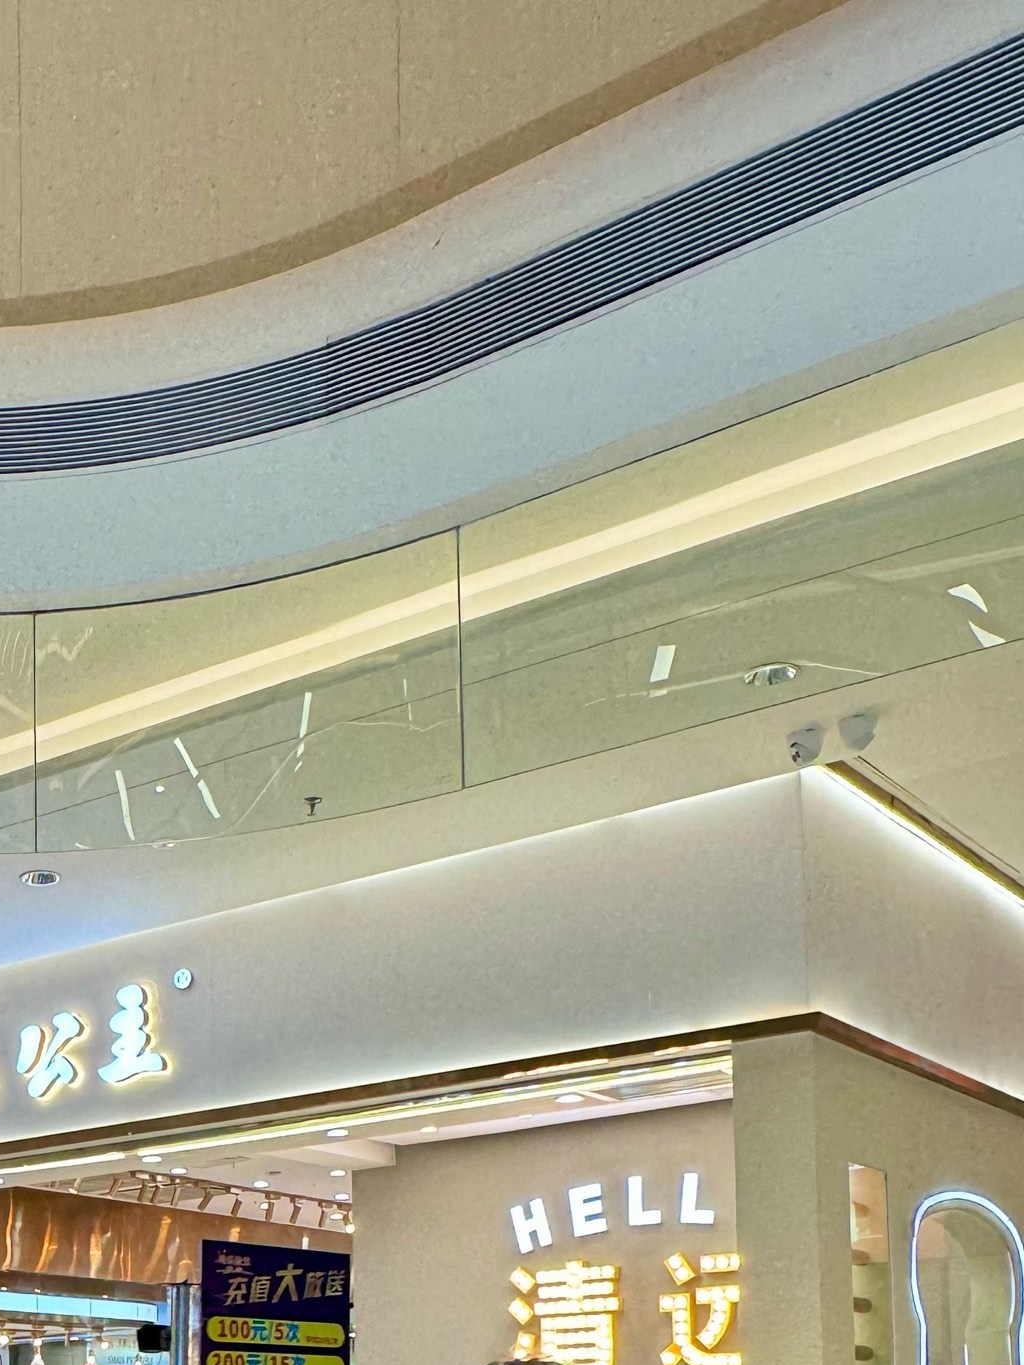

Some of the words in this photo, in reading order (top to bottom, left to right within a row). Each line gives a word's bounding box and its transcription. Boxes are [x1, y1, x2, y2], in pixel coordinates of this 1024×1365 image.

[223, 1263, 347, 1306] 充值大放送
